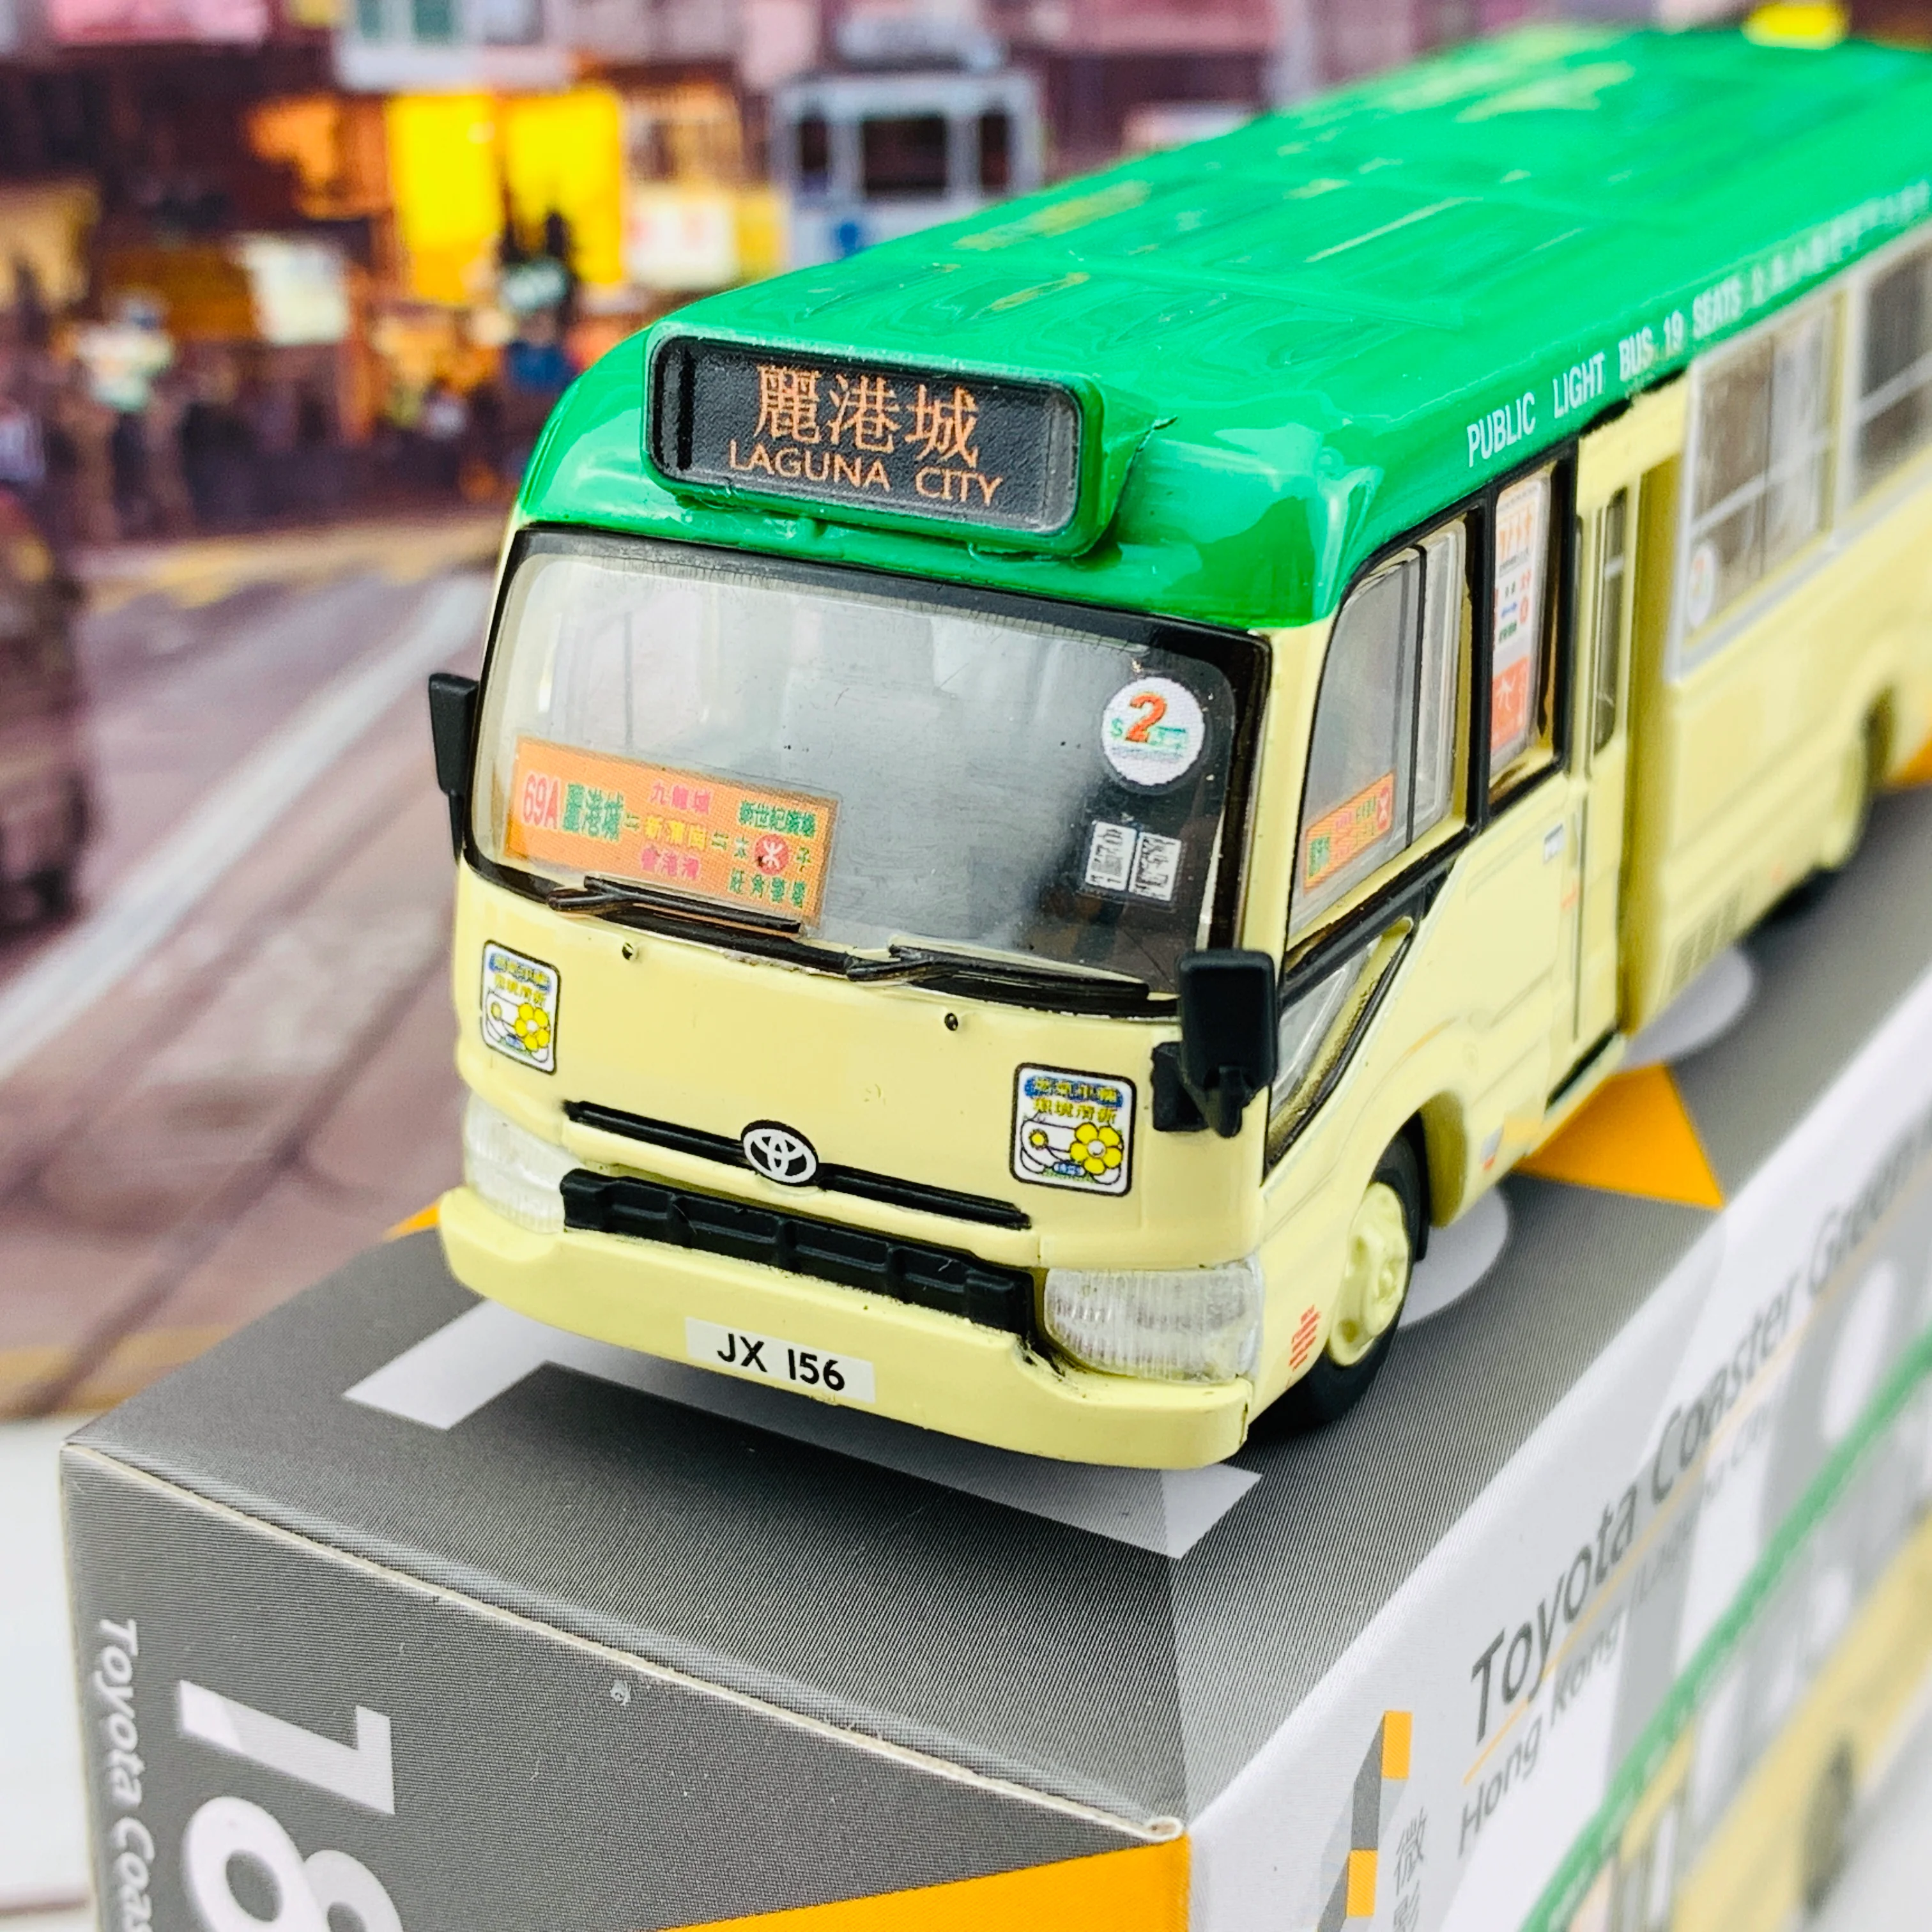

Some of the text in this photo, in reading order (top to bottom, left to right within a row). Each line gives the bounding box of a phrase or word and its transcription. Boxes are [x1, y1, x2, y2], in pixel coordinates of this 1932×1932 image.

[753, 364, 980, 469] 麗港城
[1467, 275, 1742, 468] PUBLIC LIGHT BUS 19 SEATS
[729, 439, 1003, 507] LAGUNA CITY
[523, 774, 559, 830] 69A
[716, 1333, 845, 1392] JX 156
[1470, 1481, 1639, 1746] Toyota
[1651, 1269, 1800, 1505] Coaster
[94, 1618, 146, 1809] Toyota
[1459, 1609, 1620, 1854] Hong Kong
